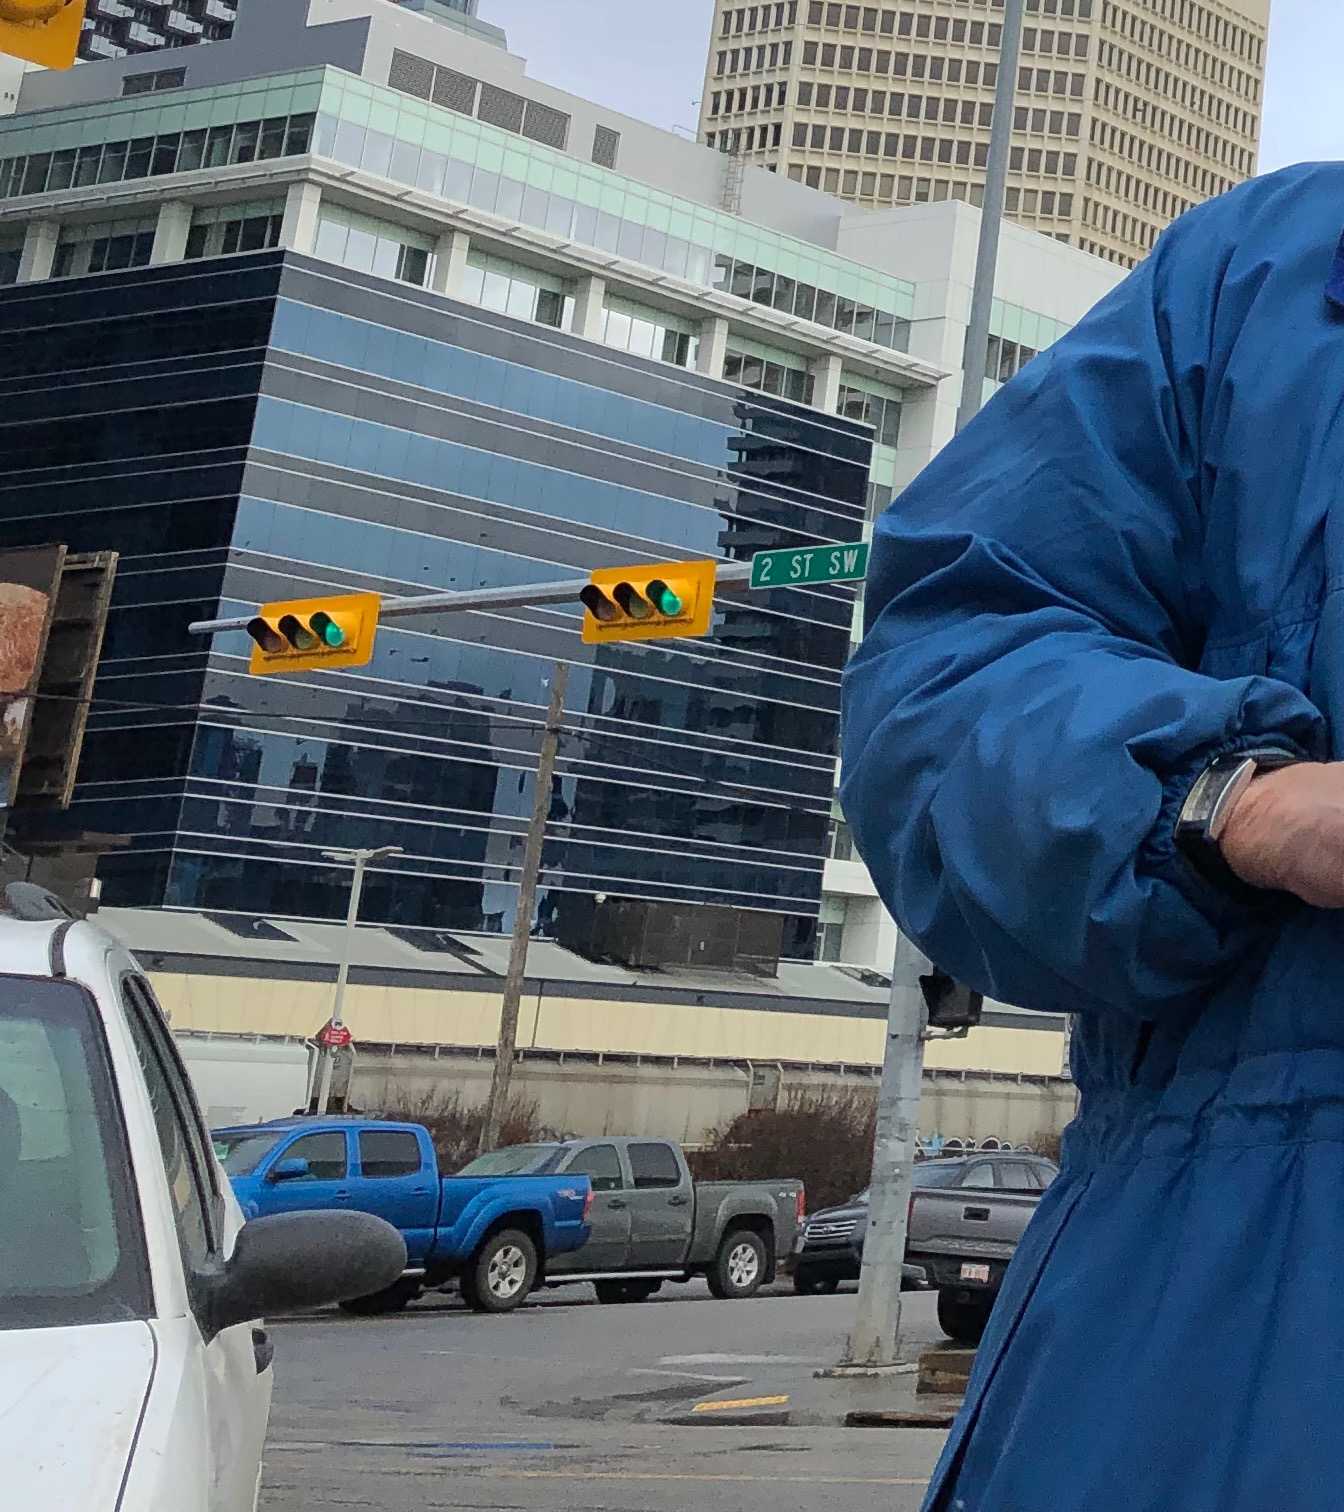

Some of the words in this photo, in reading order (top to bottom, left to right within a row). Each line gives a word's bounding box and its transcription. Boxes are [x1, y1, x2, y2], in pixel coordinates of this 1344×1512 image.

[759, 557, 773, 582] 2
[789, 553, 814, 579] ST
[828, 549, 859, 575] SW
